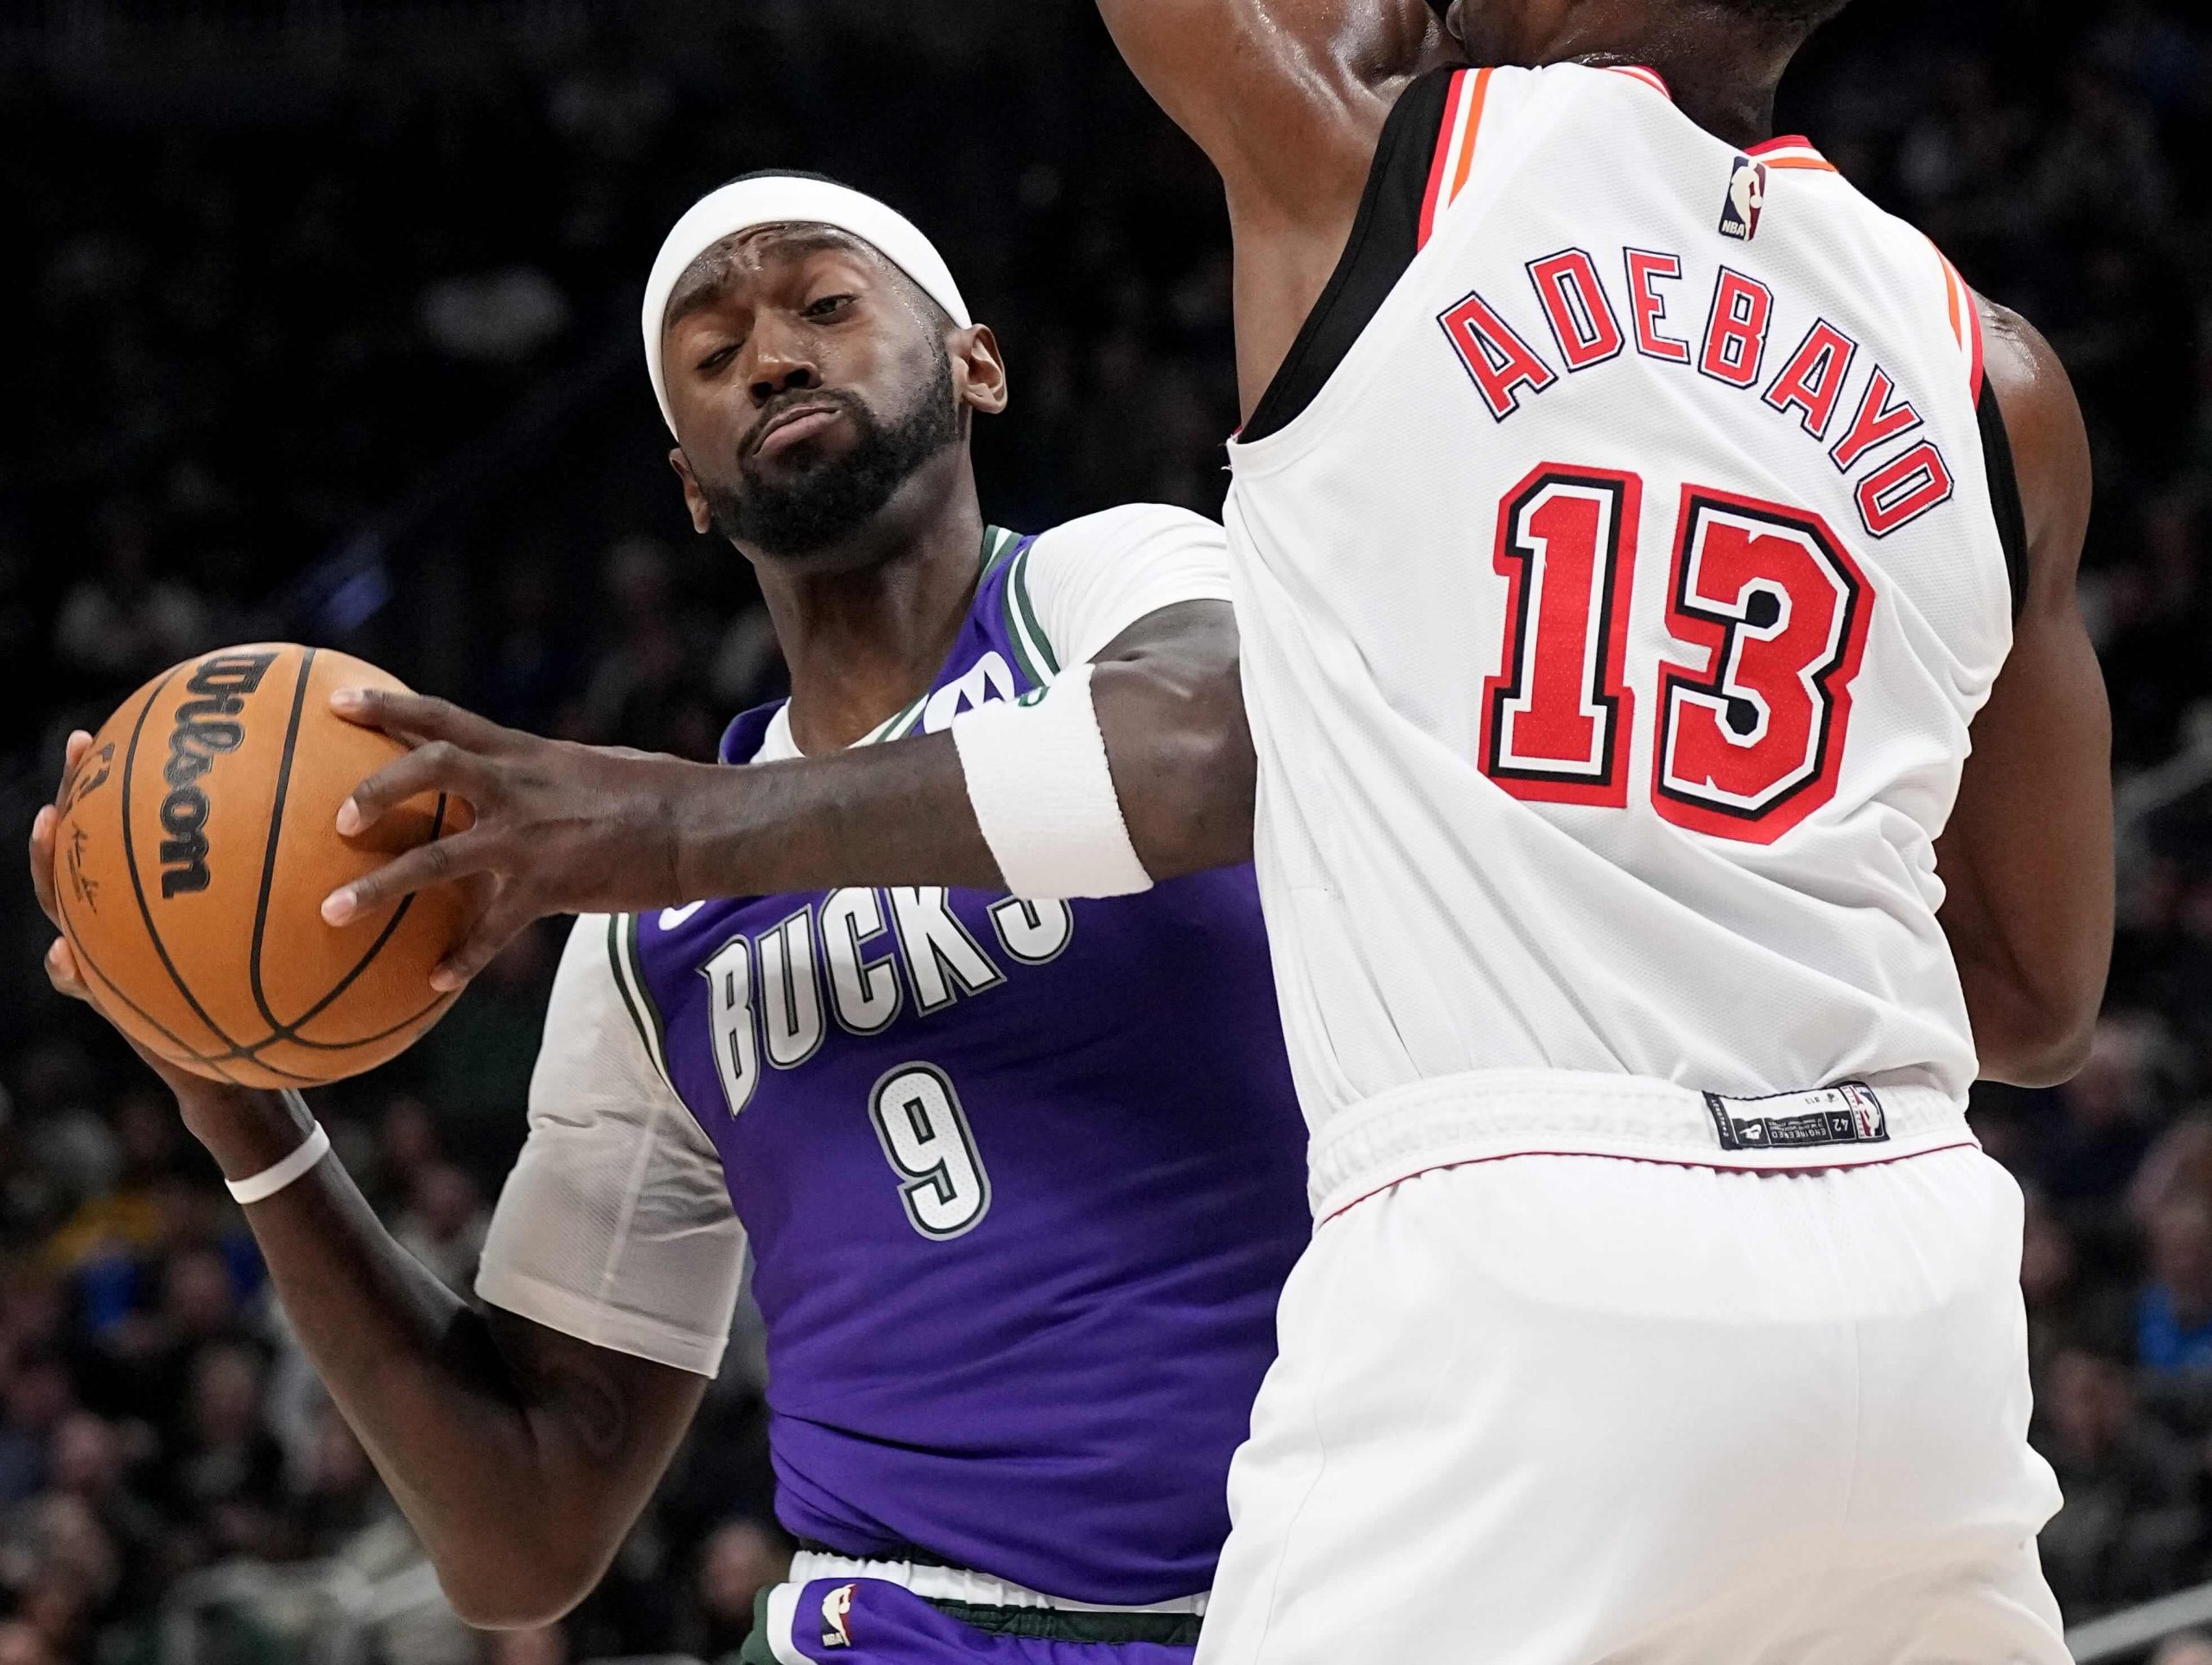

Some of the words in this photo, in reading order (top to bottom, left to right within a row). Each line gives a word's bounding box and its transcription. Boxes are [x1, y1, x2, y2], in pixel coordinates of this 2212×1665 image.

[1722, 219, 1745, 237] NBA
[1437, 247, 1954, 538] ADEBAYO
[1477, 461, 1875, 845] 13
[160, 652, 278, 899] Wilson
[868, 1060, 991, 1241] 9
[1832, 1118, 1849, 1132] 42
